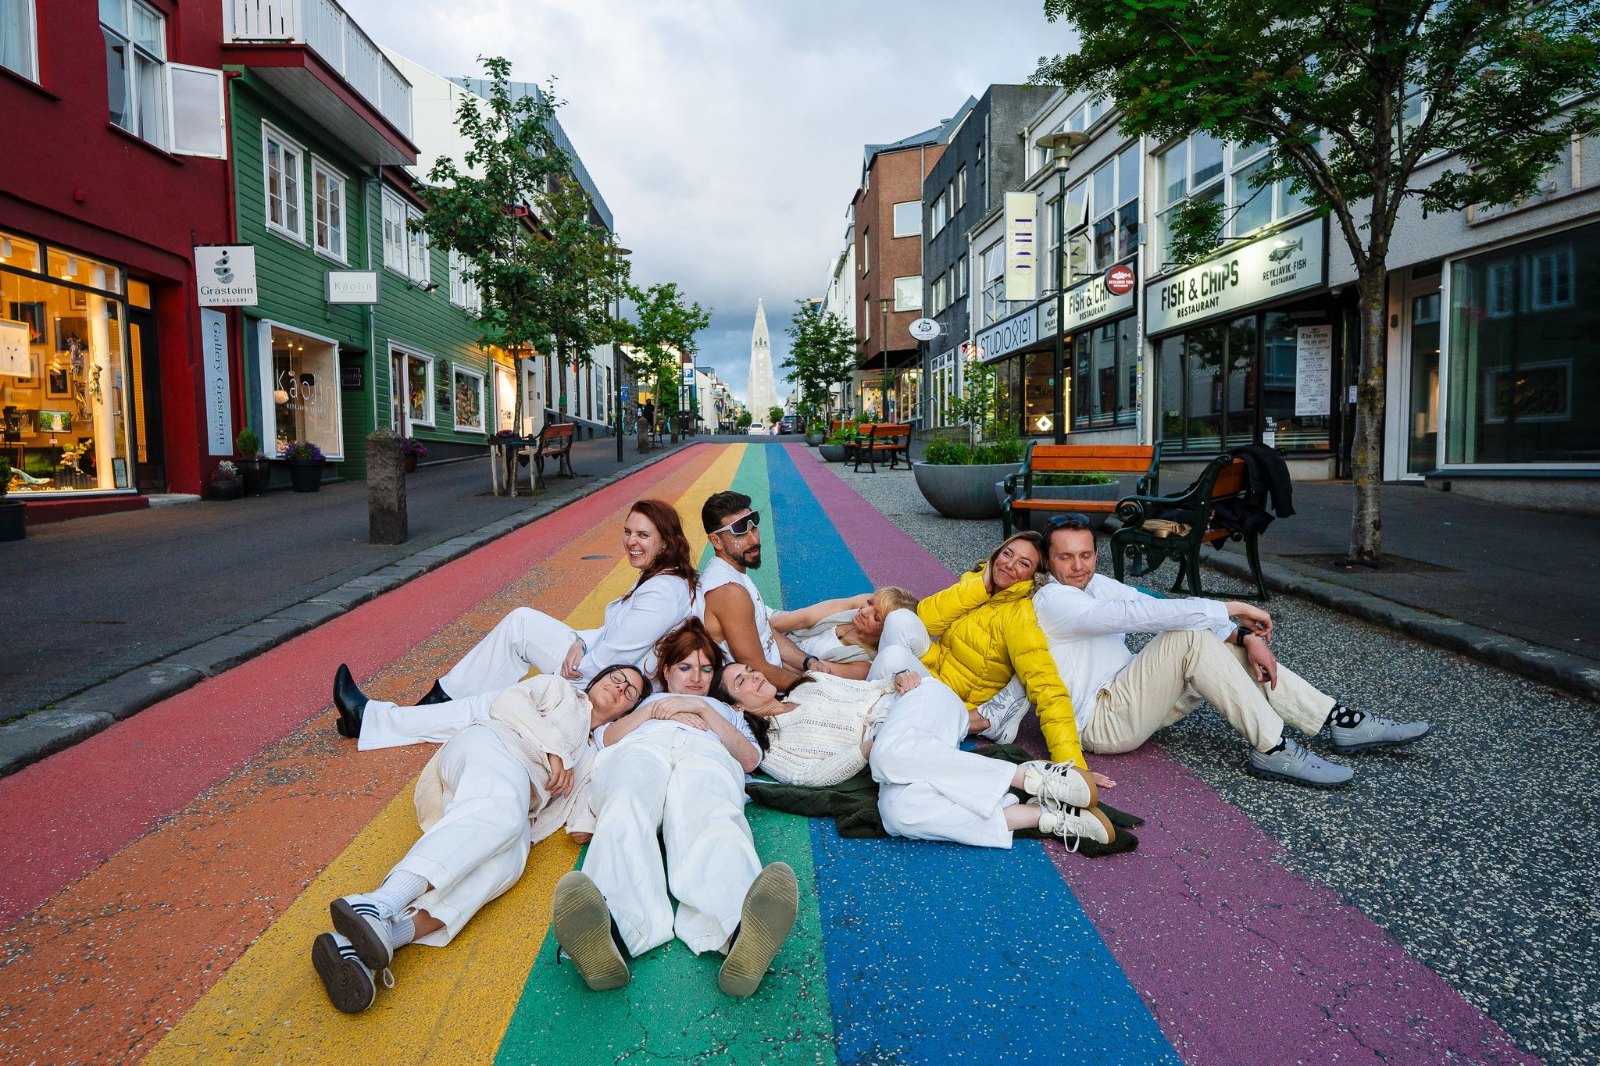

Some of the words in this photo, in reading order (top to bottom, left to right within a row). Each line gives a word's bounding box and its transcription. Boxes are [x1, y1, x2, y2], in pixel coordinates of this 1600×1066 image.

[1262, 263, 1291, 281] REYKJAVIK
[1293, 257, 1307, 271] FISH
[1270, 272, 1297, 287] RESTAURANT
[200, 285, 254, 296] Grásteinn
[334, 281, 372, 291] Kaolin
[1069, 290, 1085, 314] FISH
[1094, 281, 1110, 304] CHI
[1161, 280, 1185, 312] FISH
[1188, 277, 1198, 301] &
[1201, 259, 1239, 297] CHIPS
[1079, 303, 1107, 321] RESTAURANT
[1177, 296, 1220, 319] RESTAURANT
[213, 321, 223, 374] Gallery
[981, 326, 1012, 359] STUDIO
[276, 368, 334, 403] Kaolin
[216, 377, 227, 446] Grásteinn
